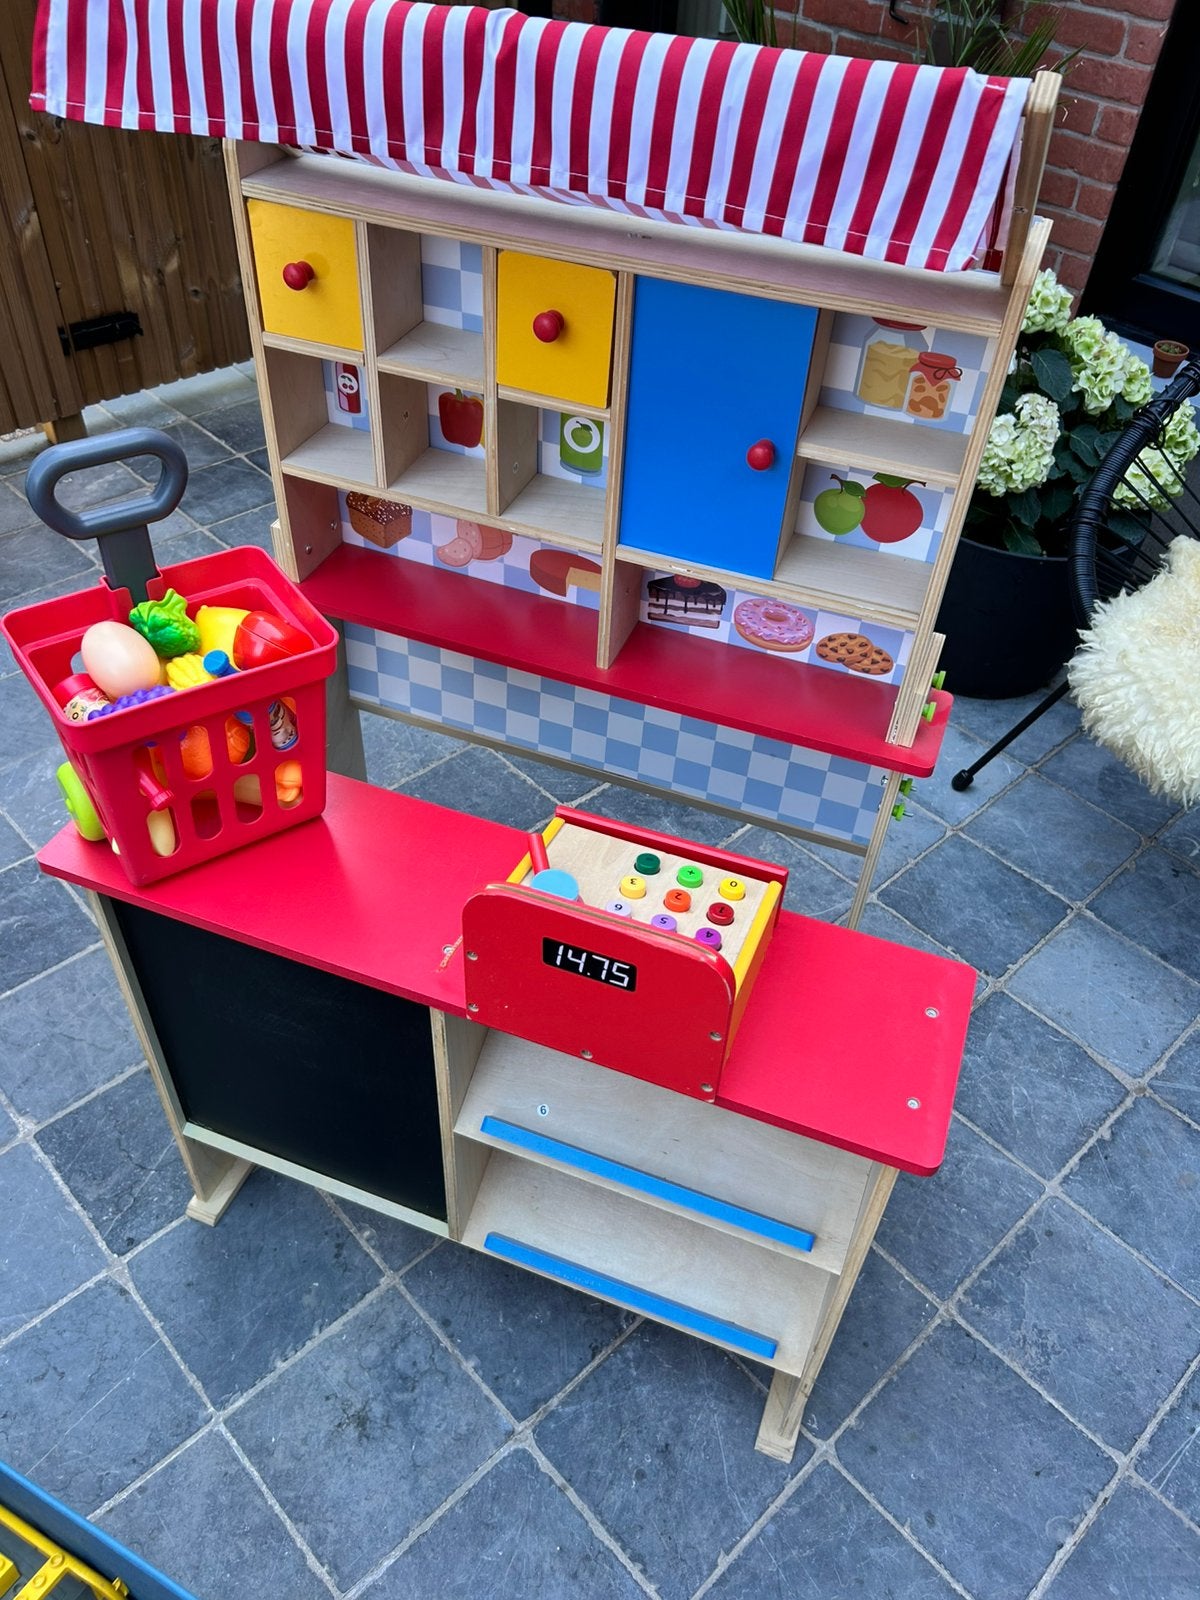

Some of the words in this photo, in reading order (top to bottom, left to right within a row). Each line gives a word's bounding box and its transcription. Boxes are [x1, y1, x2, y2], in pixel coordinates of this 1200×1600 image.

[630, 877, 638, 886] 3
[729, 880, 738, 888] 0
[674, 892, 683, 901] 2
[719, 906, 726, 914] 1
[660, 916, 669, 925] 5
[705, 930, 714, 938] 4
[555, 944, 631, 988] 14.75
